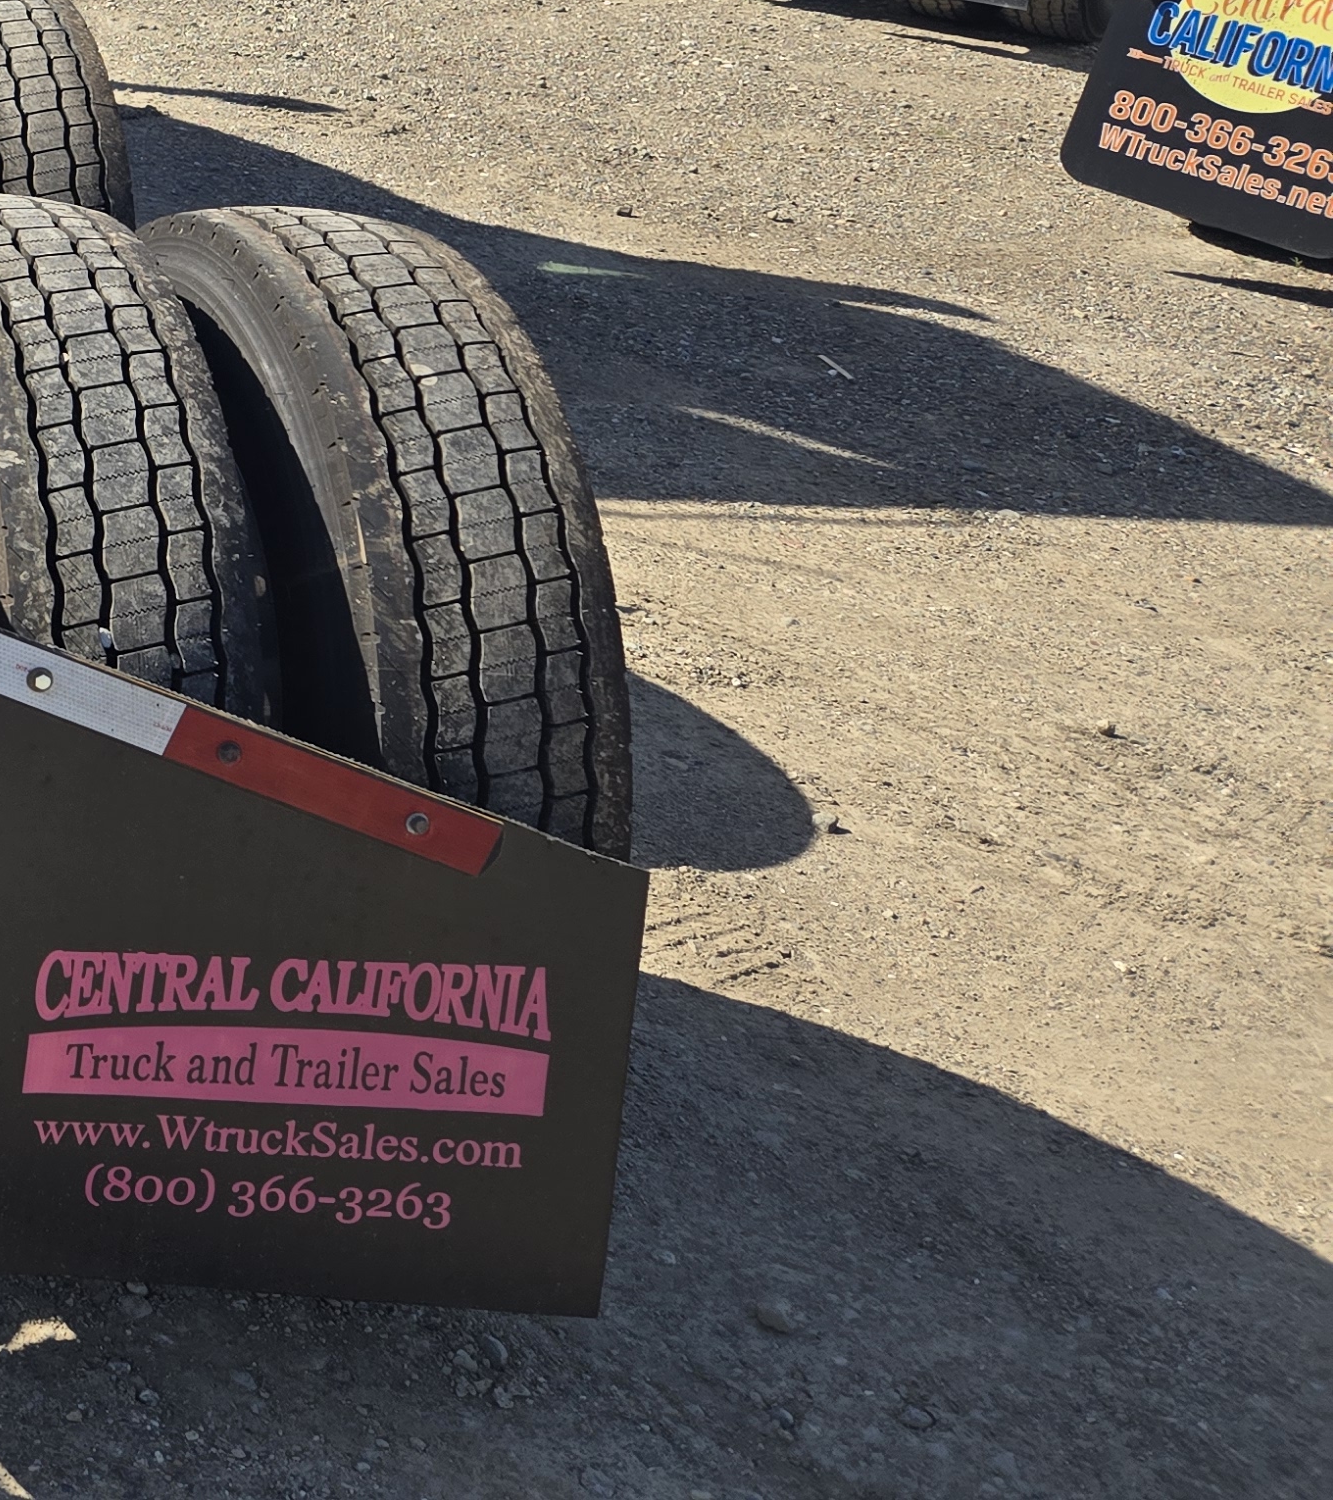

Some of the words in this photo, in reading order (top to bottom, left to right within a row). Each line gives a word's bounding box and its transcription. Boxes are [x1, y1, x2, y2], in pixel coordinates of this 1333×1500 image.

[1147, 0, 1333, 94] CALIFORN
[1162, 55, 1208, 80] TRUCK
[1209, 71, 1231, 83] and
[1232, 76, 1286, 101] TRAILER
[1109, 89, 1333, 185] 800-366-326
[34, 950, 260, 1022] CENTRAL
[269, 958, 553, 1042] CALIFORNIA
[66, 1040, 175, 1083] Truck
[185, 1041, 257, 1086] and
[271, 1042, 400, 1092] Trailer
[409, 1050, 507, 1099] Sales
[33, 1114, 523, 1169] www.WtruckSales.com
[83, 1162, 216, 1213] (800)
[227, 1174, 452, 1230] 366-3263
